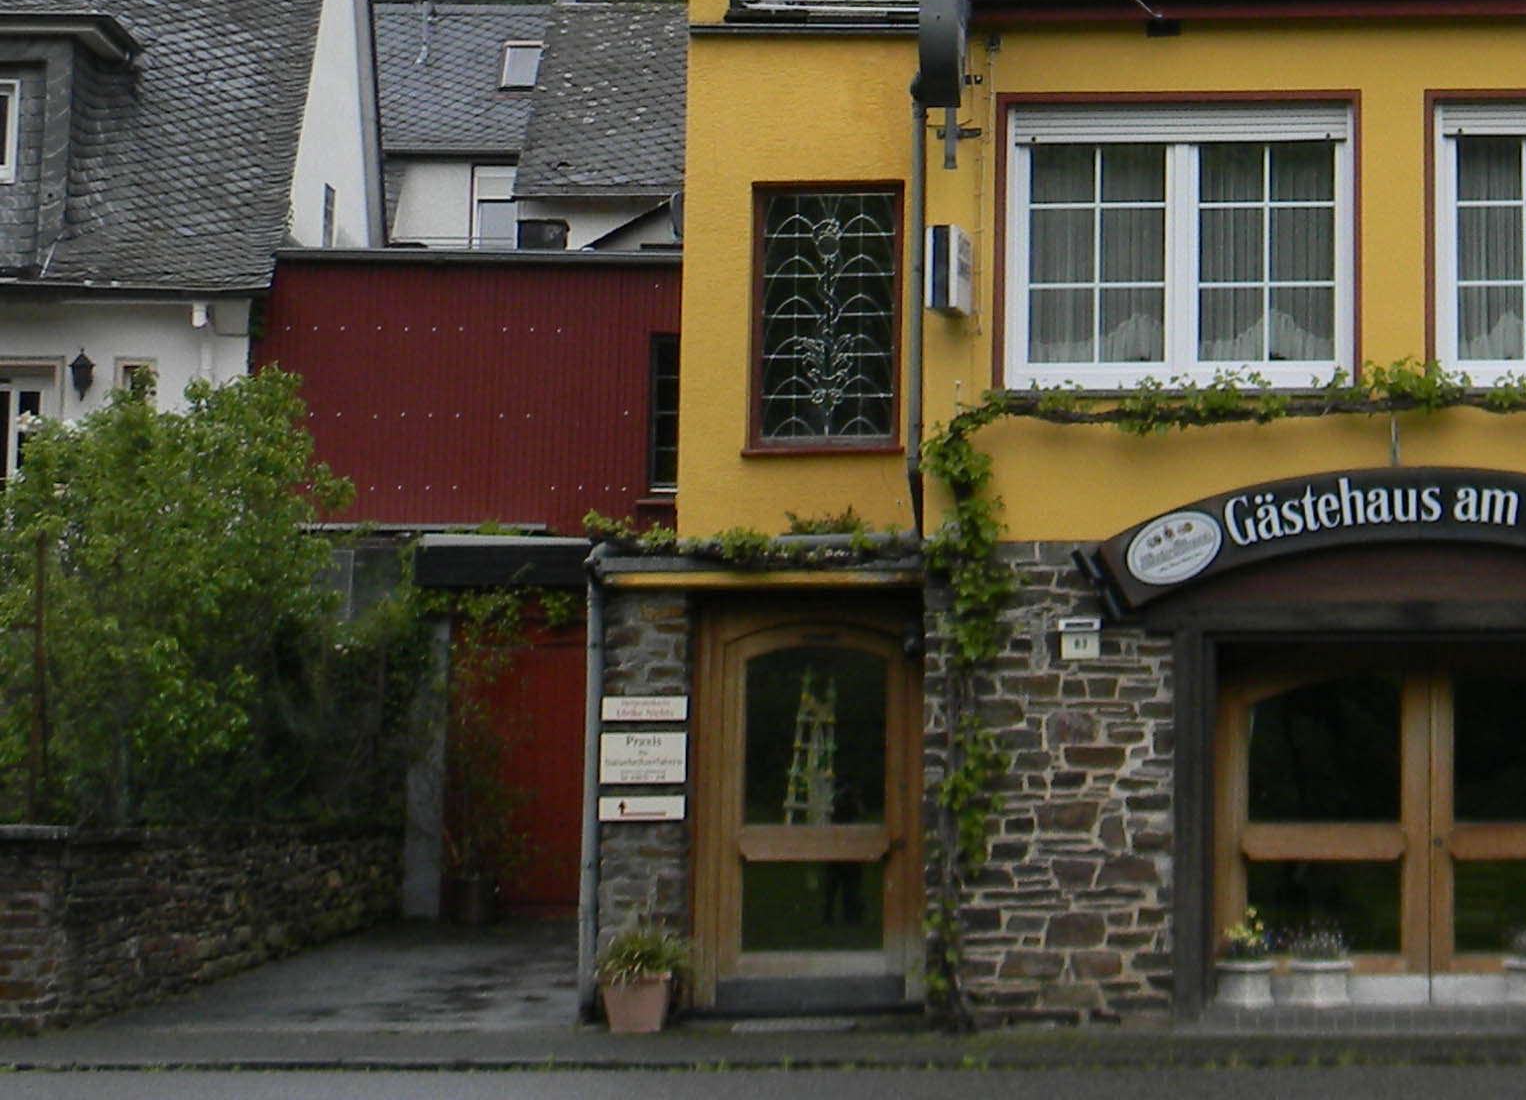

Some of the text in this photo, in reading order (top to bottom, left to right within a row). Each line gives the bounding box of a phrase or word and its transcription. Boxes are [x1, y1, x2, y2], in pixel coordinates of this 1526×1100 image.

[1223, 476, 1441, 546] Gästehaus
[1453, 486, 1518, 525] am
[625, 734, 663, 748] Praxis
